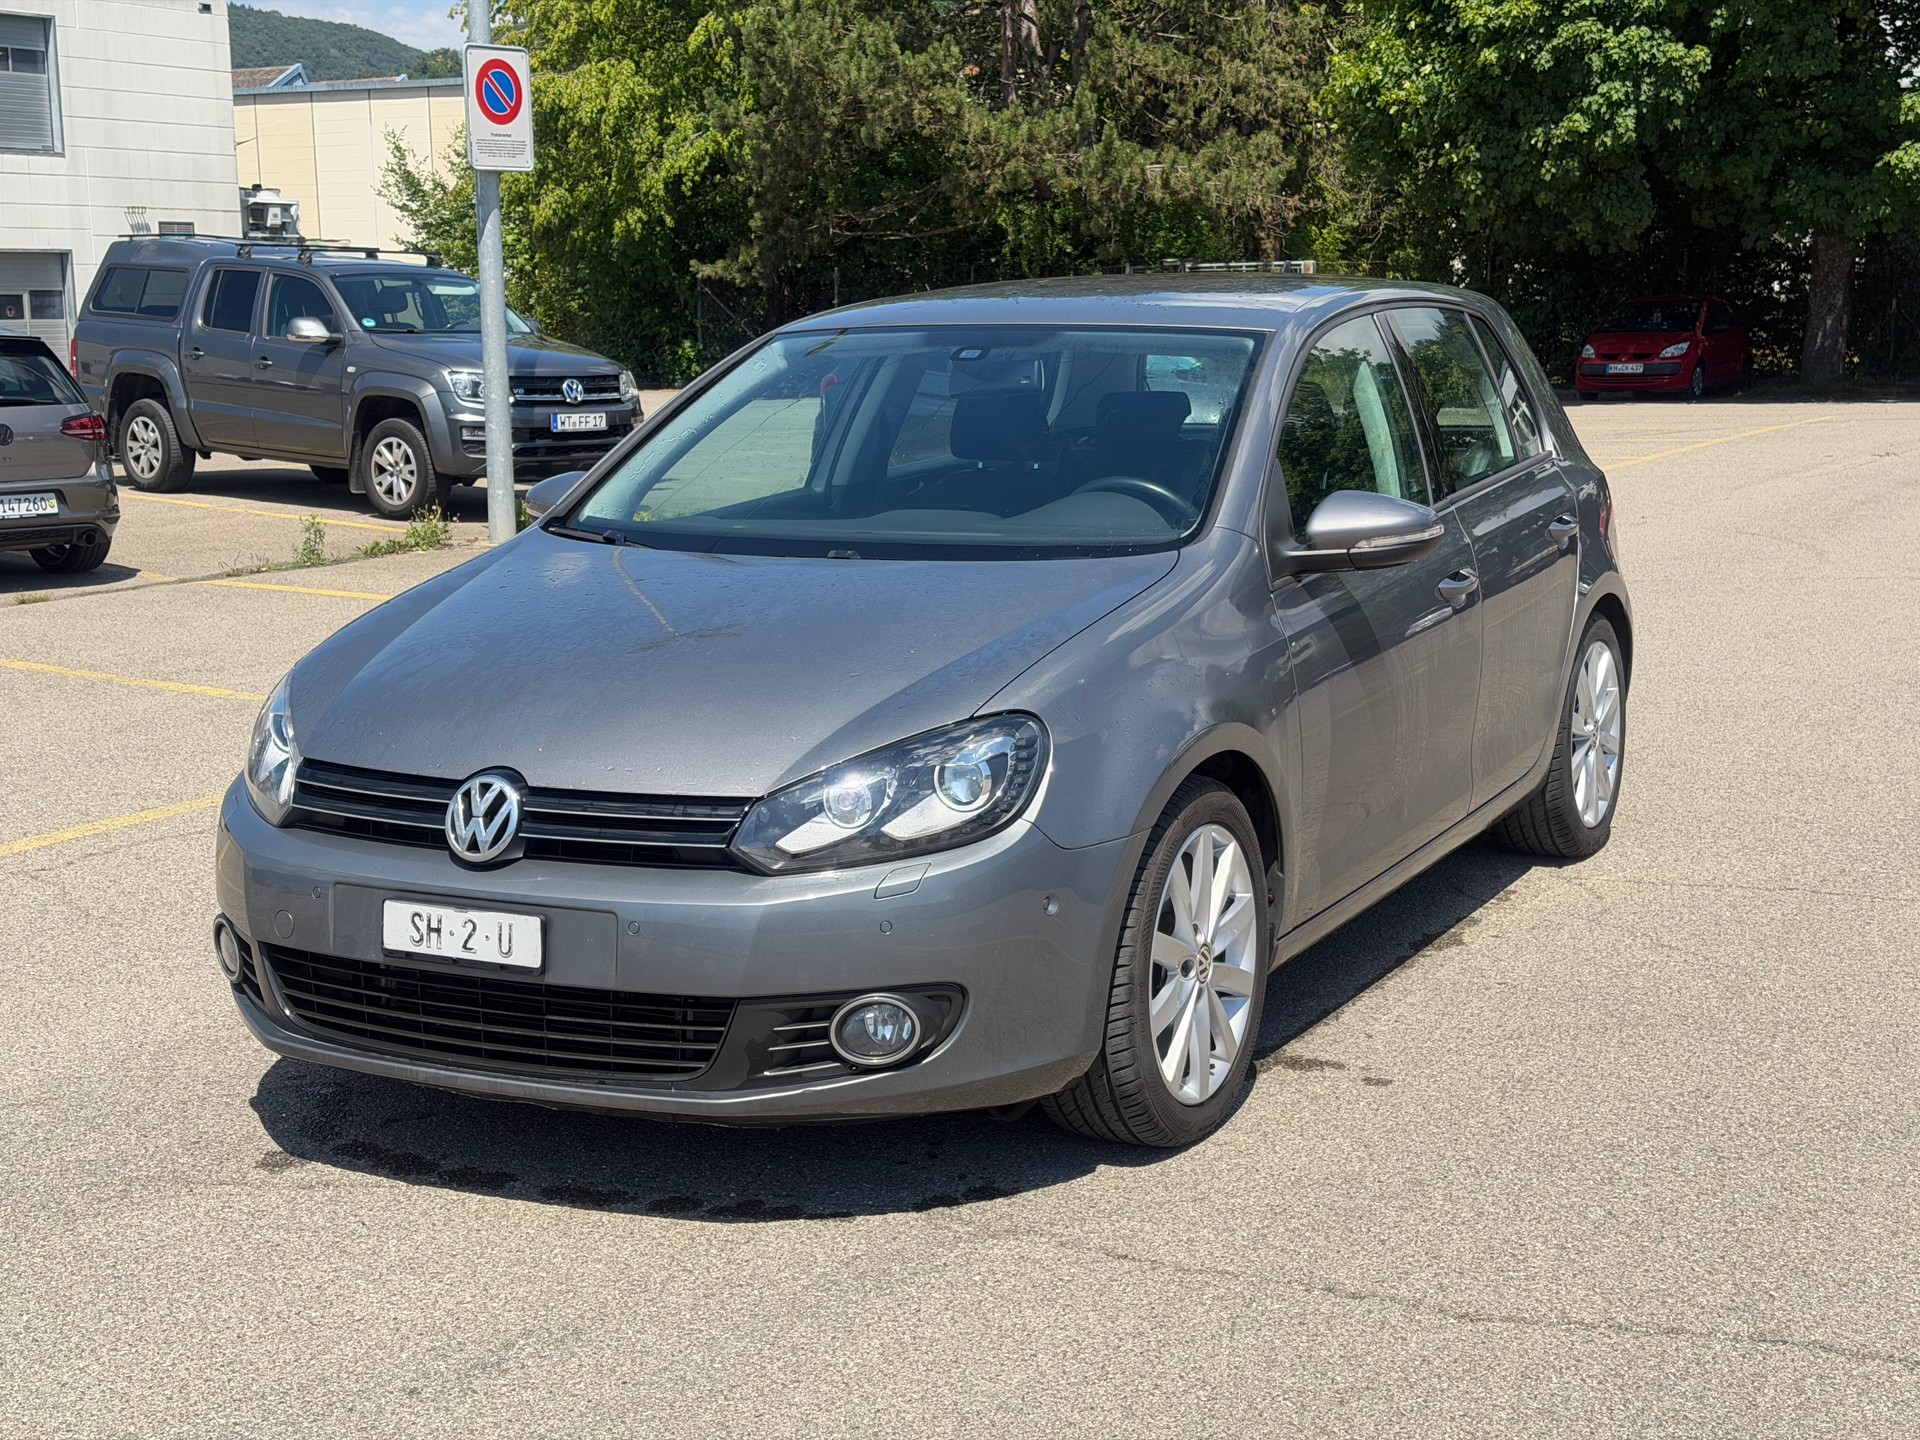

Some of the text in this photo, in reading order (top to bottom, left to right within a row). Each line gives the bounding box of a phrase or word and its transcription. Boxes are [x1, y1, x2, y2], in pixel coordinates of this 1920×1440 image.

[559, 415, 604, 428] WT FF 17
